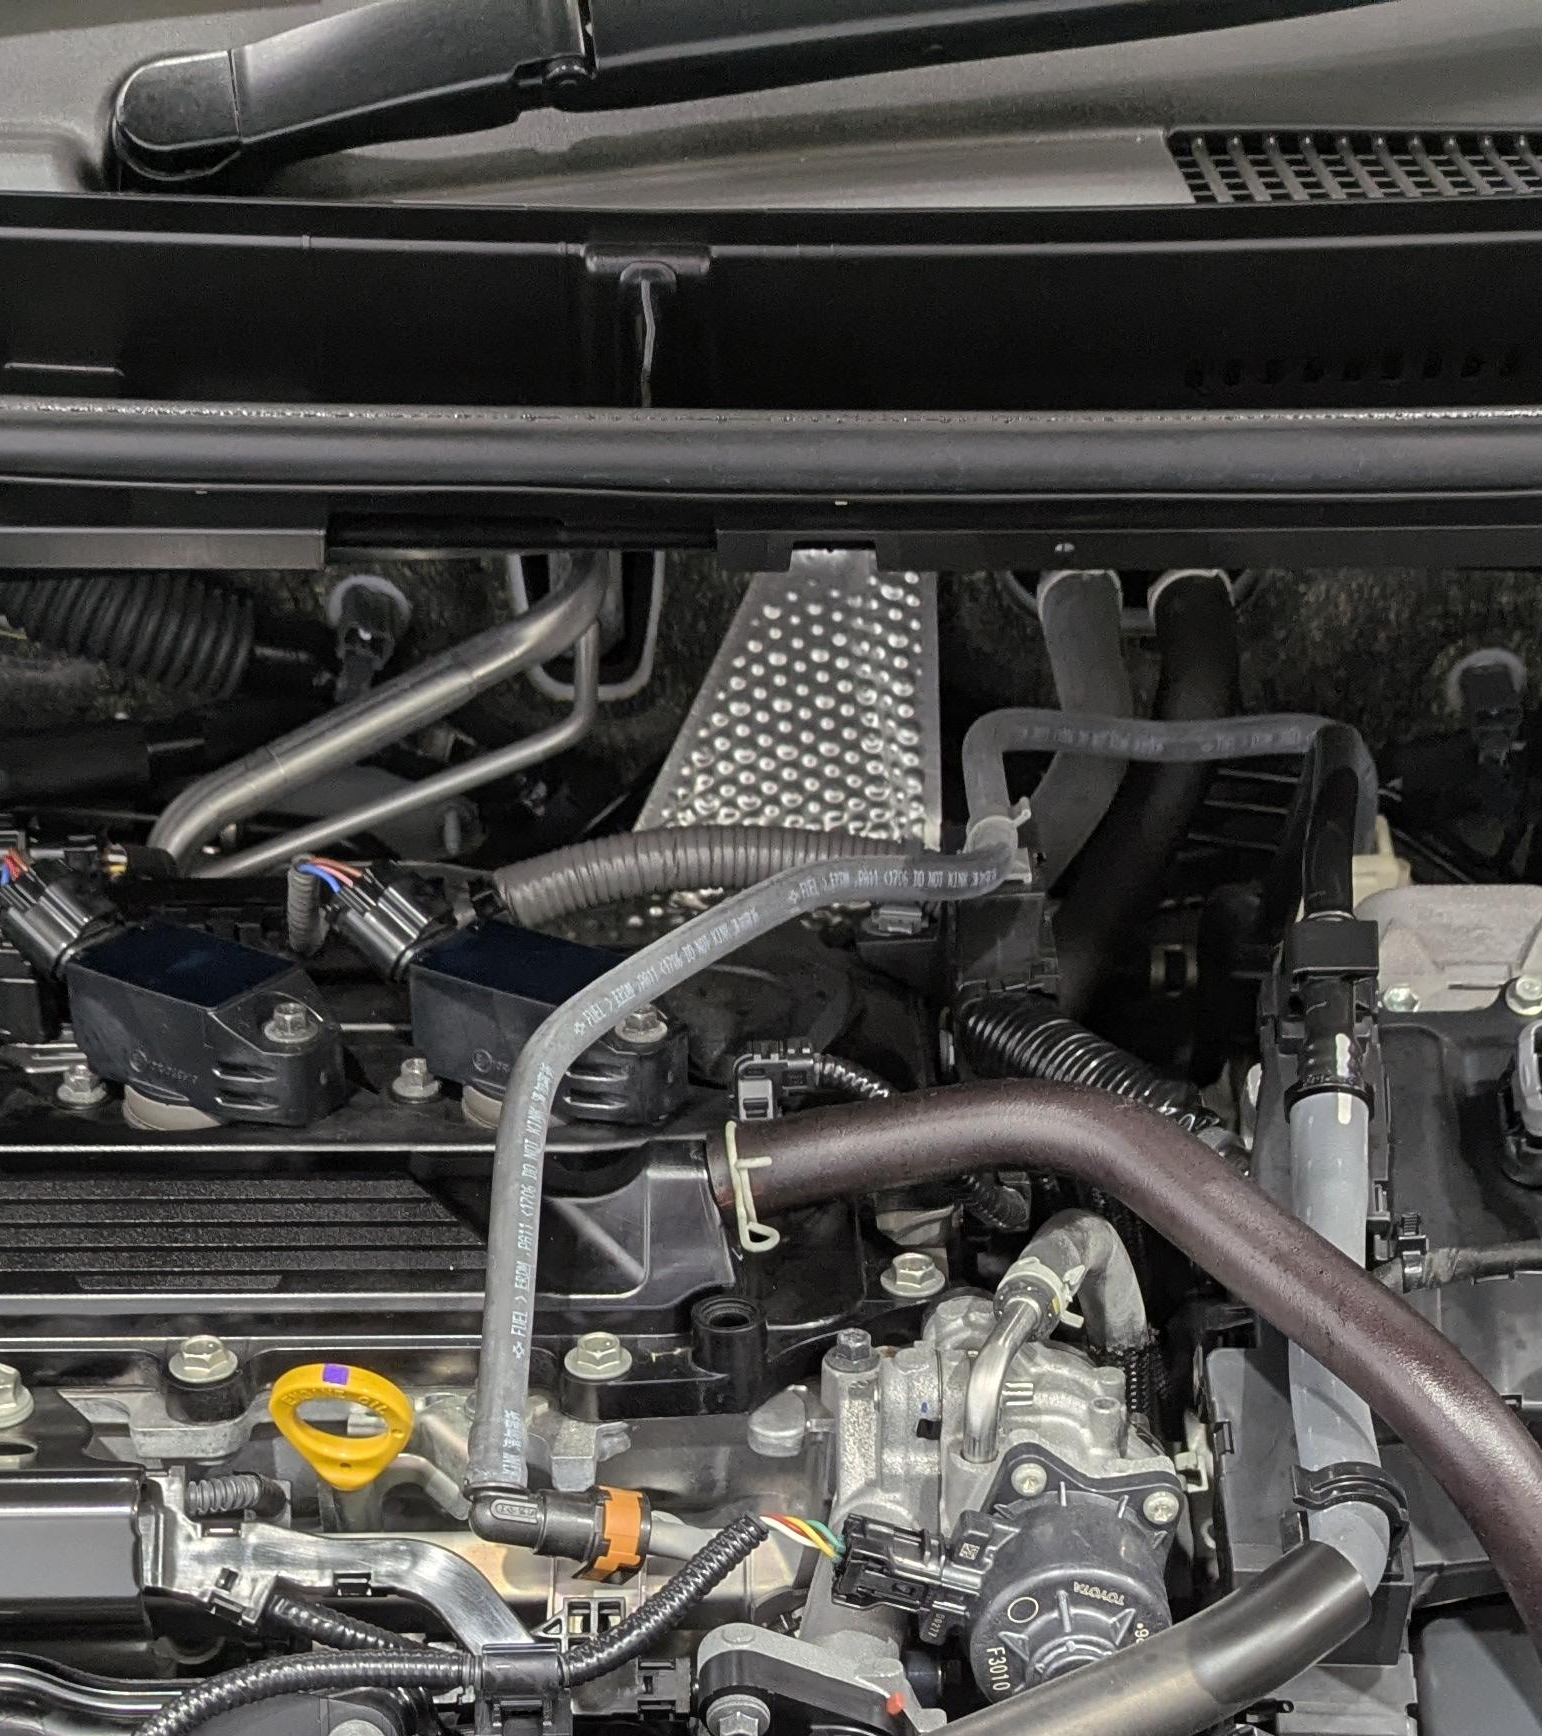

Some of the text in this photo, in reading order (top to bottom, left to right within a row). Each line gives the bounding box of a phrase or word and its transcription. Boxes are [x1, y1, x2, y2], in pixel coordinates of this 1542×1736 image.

[526, 1106, 543, 1136] KINK
[523, 1138, 542, 1161] NOT
[522, 1164, 538, 1180] DO
[511, 1311, 528, 1337] FUEL
[359, 1395, 389, 1415] OIL
[1073, 1581, 1125, 1606] TOYOTA
[986, 1647, 1011, 1692] F3010
